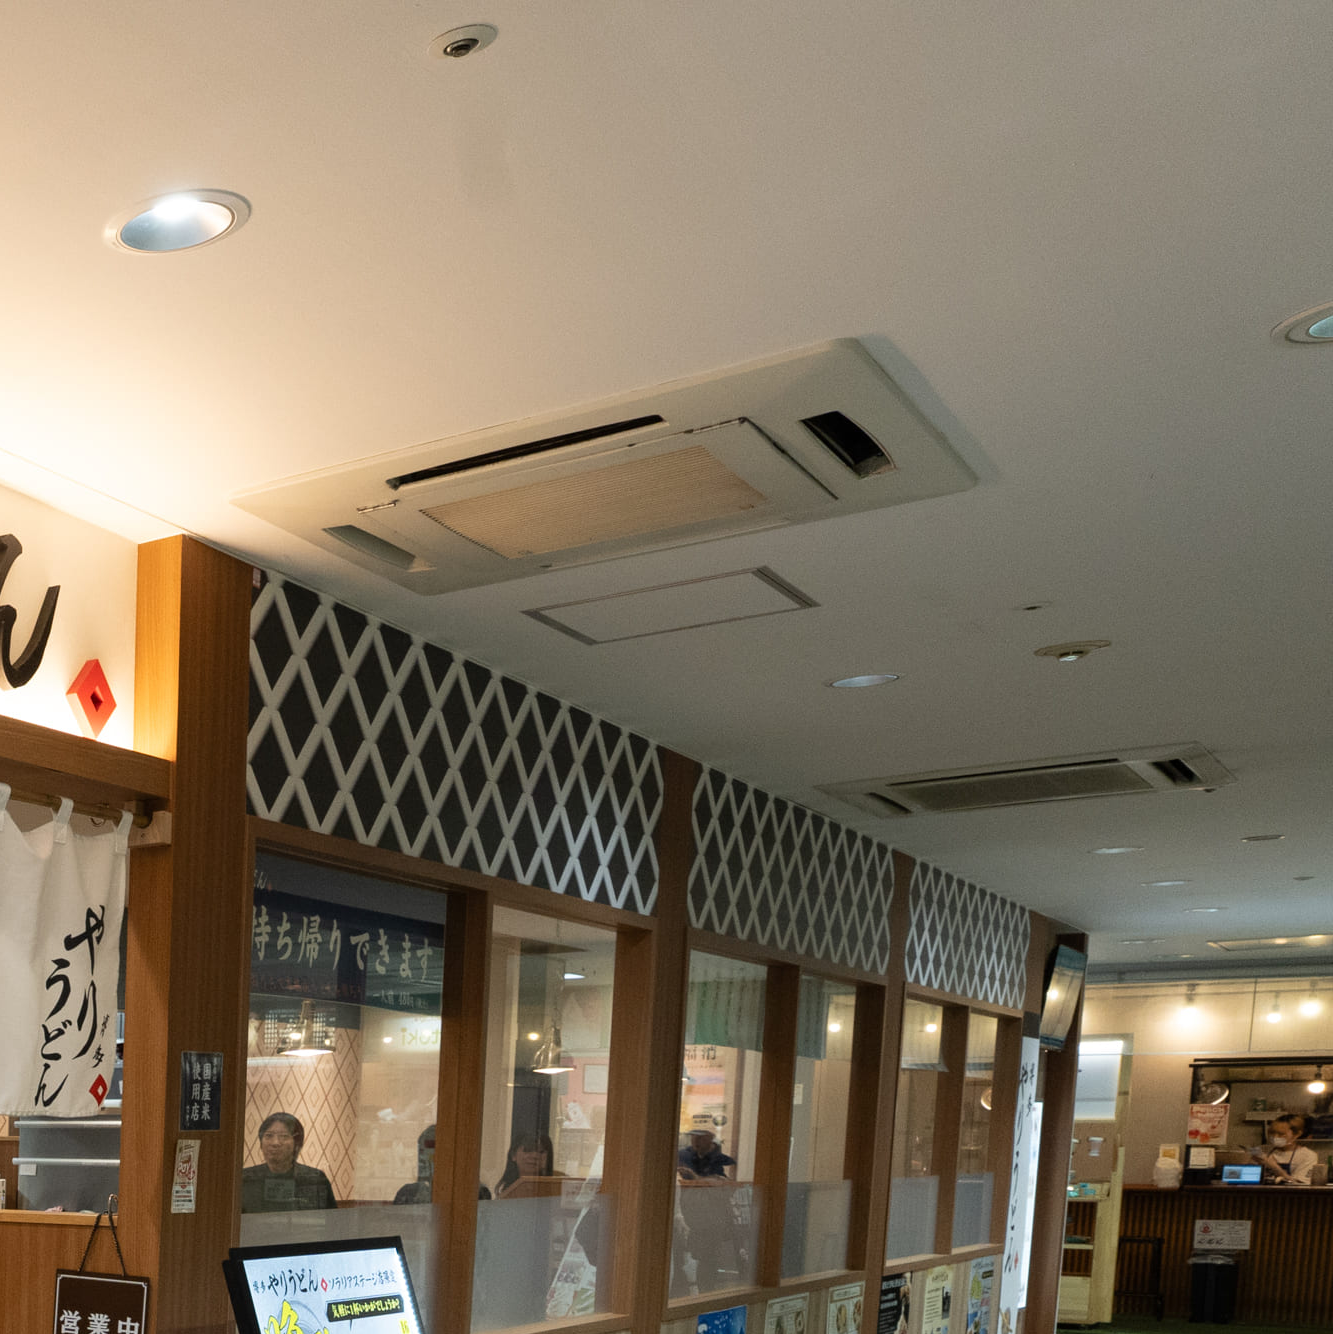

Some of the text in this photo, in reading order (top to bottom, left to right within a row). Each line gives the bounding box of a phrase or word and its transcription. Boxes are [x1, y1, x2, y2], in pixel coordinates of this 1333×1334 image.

[252, 904, 433, 982] 持ち帰りできます
[191, 1062, 202, 1120] 使用店
[201, 1063, 212, 1120] 国産米
[268, 1267, 319, 1296] やりうどん
